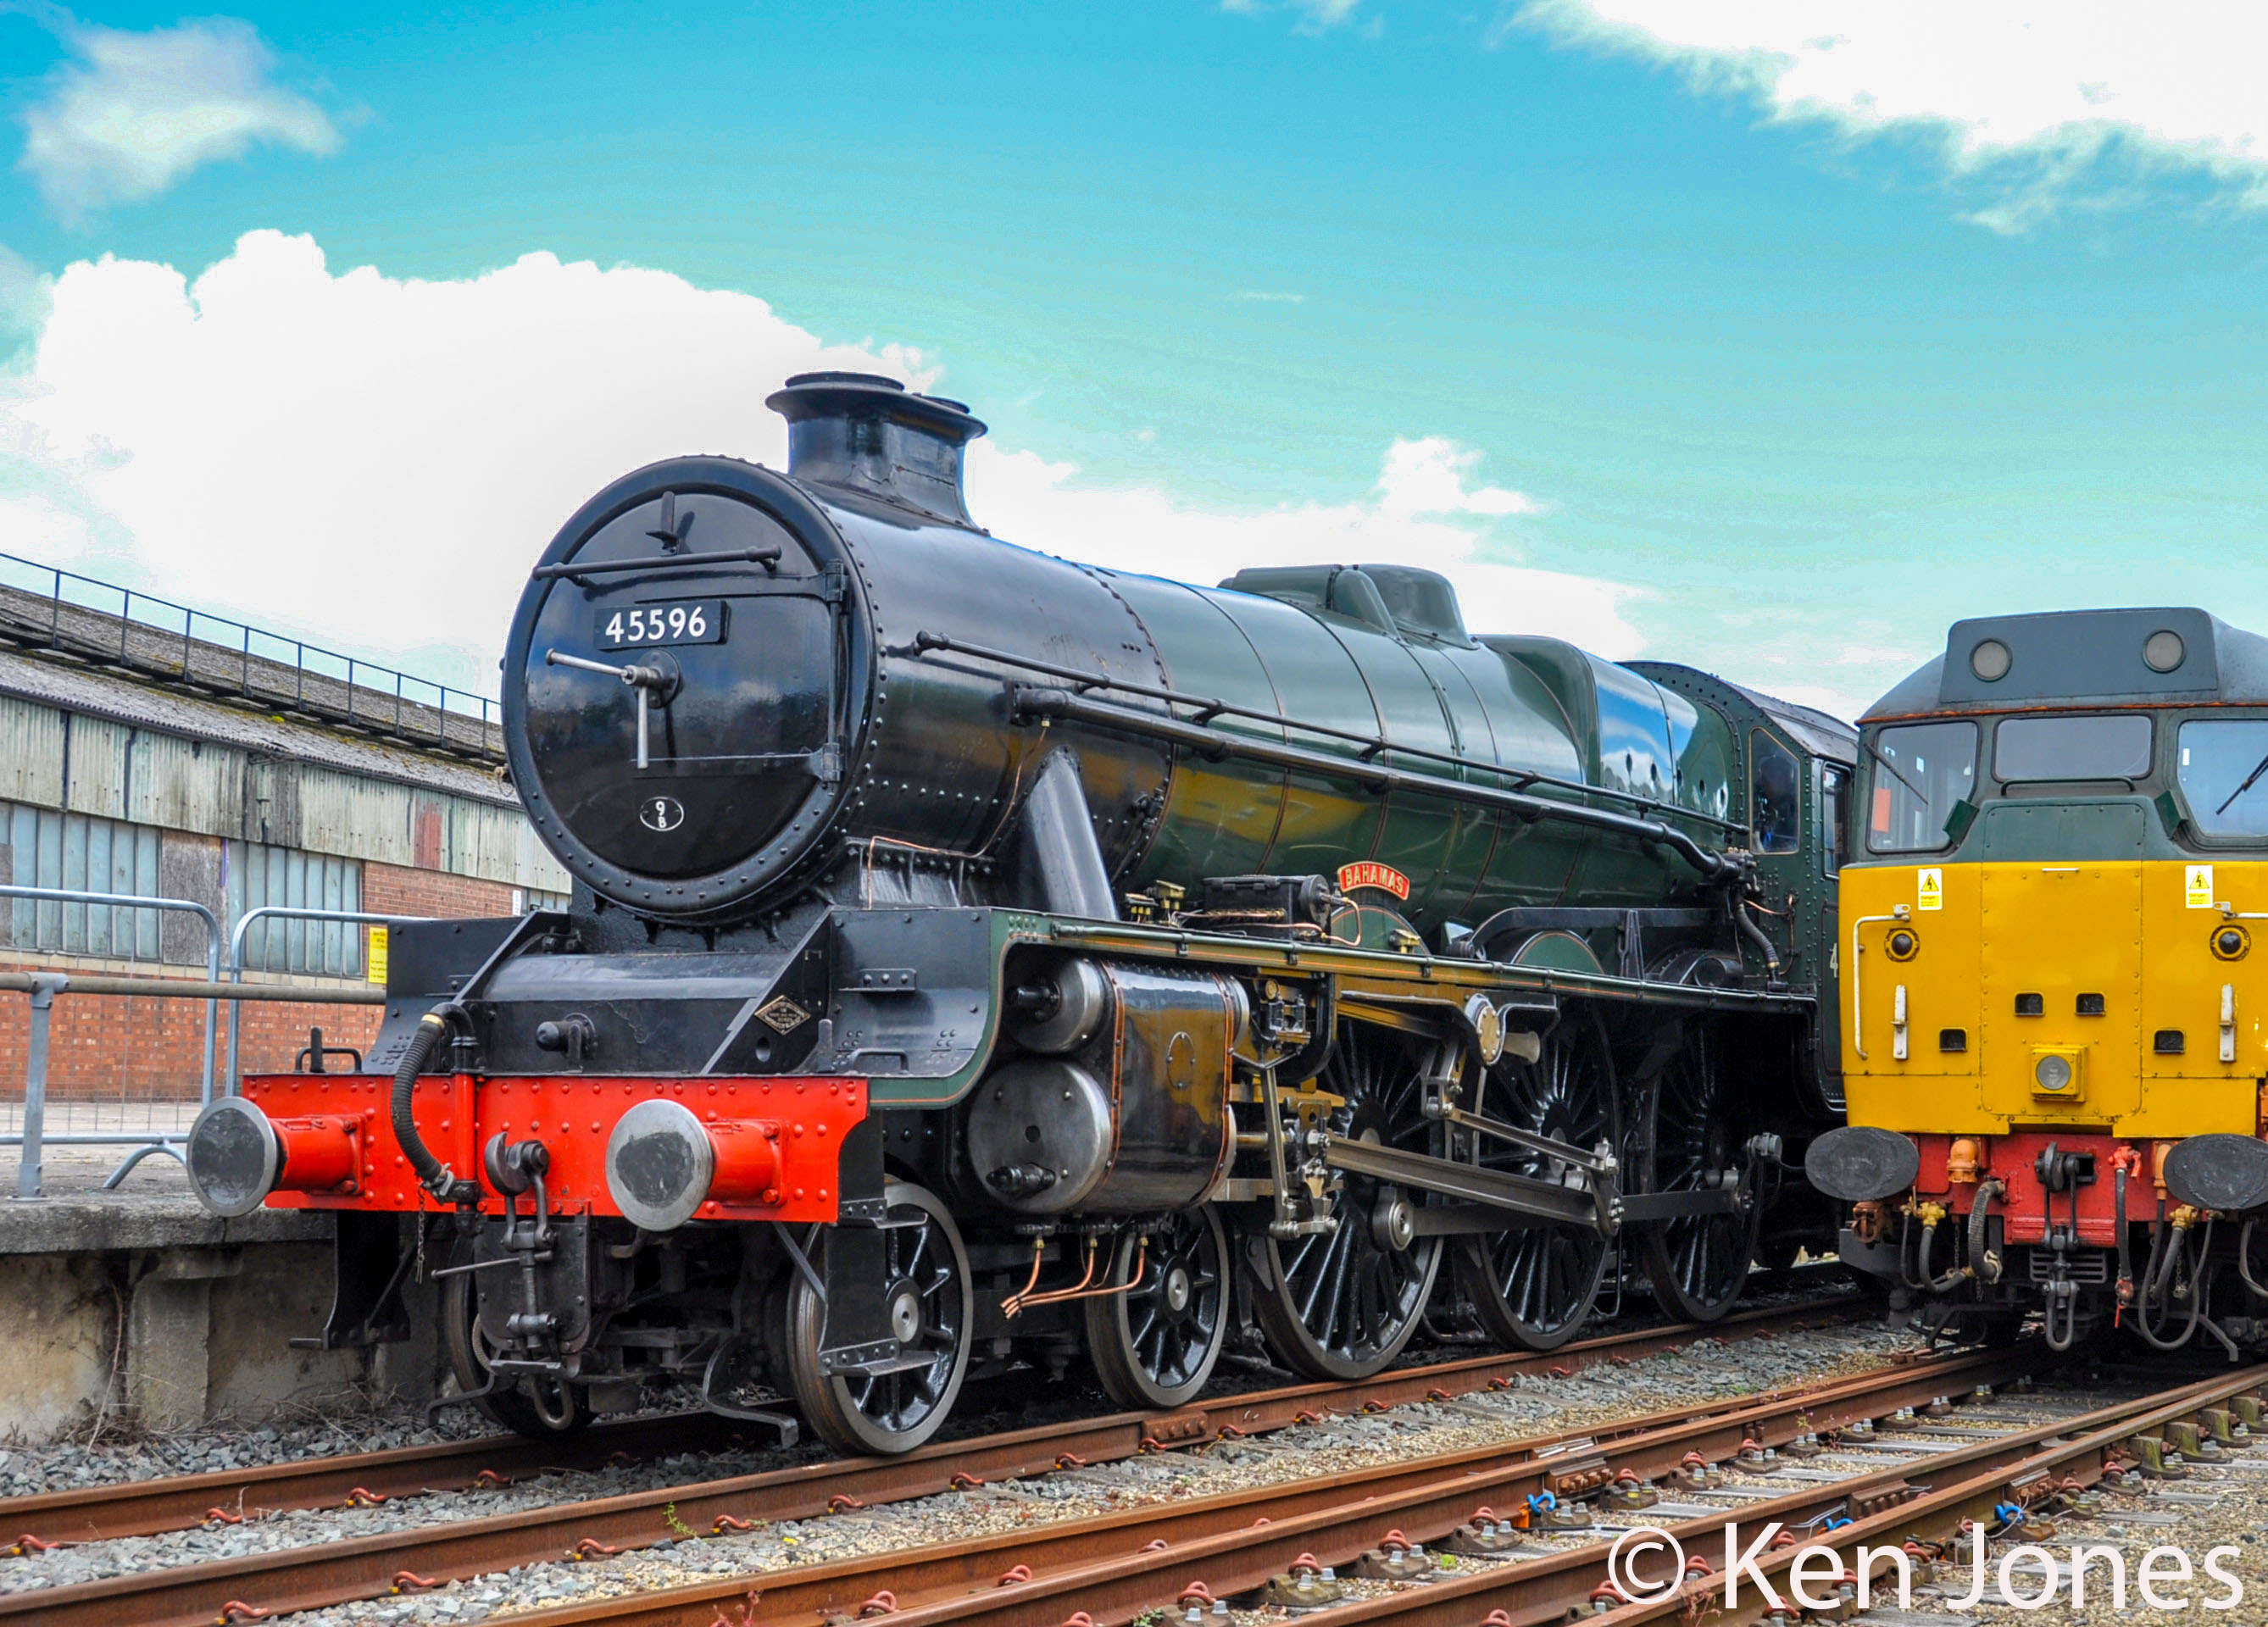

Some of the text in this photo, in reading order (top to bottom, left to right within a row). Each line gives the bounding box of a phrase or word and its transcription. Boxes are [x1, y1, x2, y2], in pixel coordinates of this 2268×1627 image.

[604, 606, 706, 644] 45596
[655, 800, 665, 816] 9
[658, 816, 667, 829] B
[1344, 863, 1404, 894] BAHAMAS
